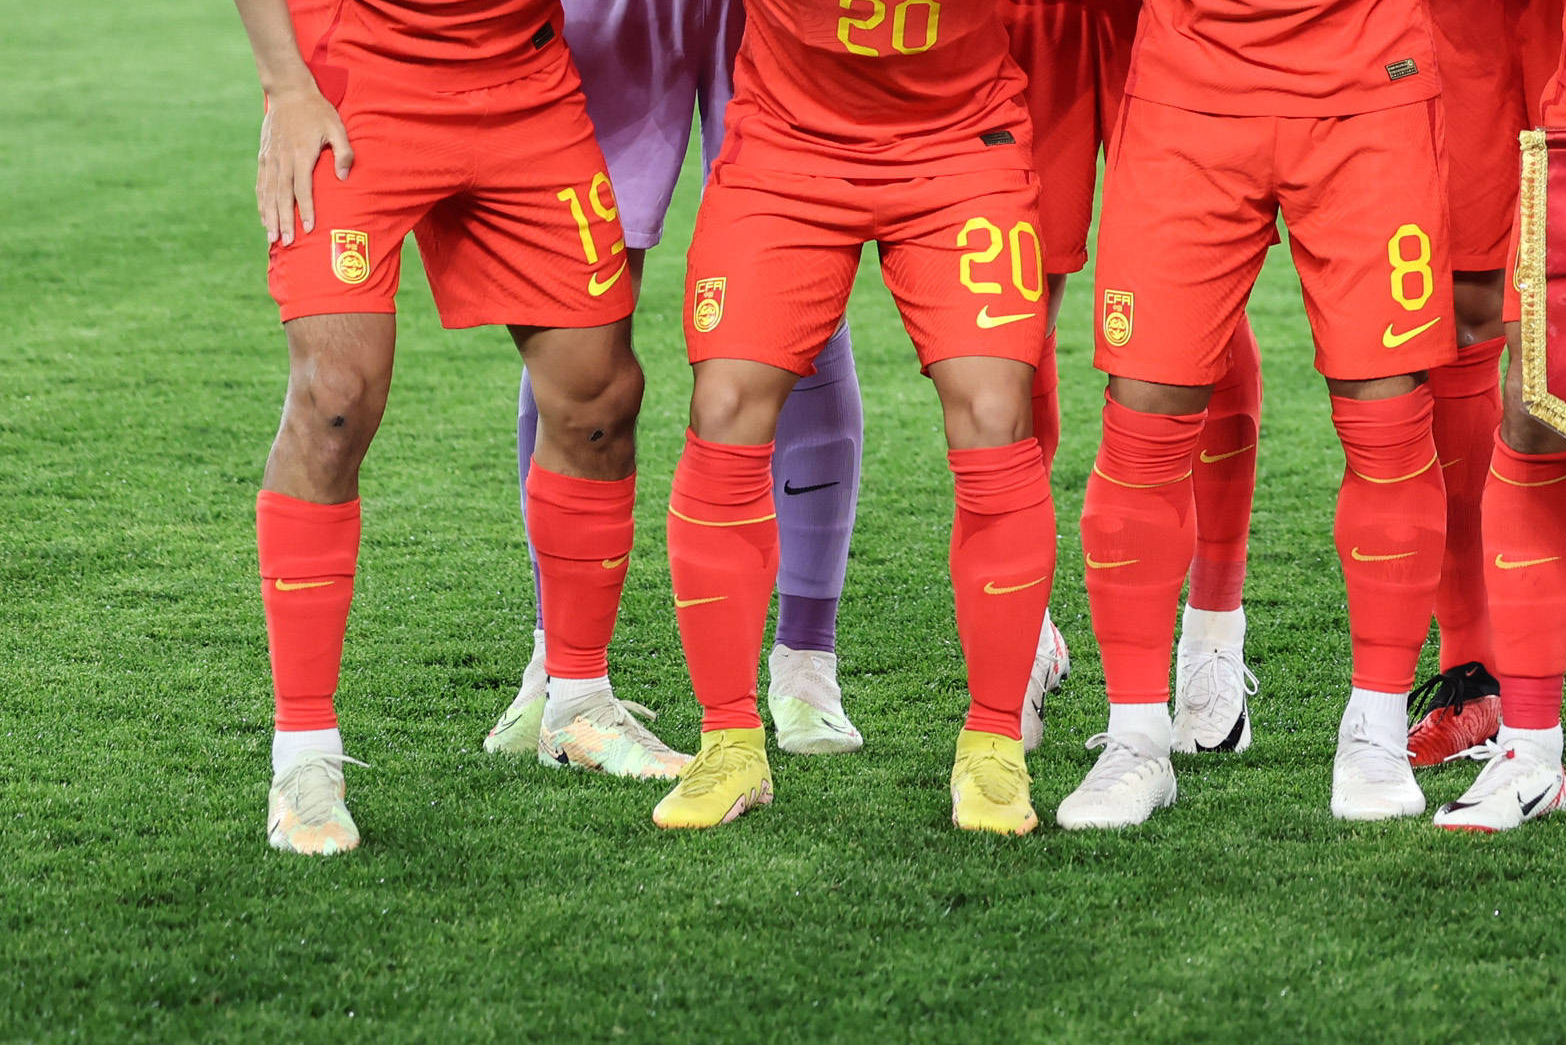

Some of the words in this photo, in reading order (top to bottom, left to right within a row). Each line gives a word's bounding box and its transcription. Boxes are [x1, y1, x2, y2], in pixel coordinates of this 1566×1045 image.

[335, 233, 366, 246] CFA
[557, 171, 625, 264] 19
[956, 216, 1043, 302] 20
[1388, 224, 1433, 311] 8
[697, 281, 723, 293] CFA
[1107, 293, 1131, 306] CFA
